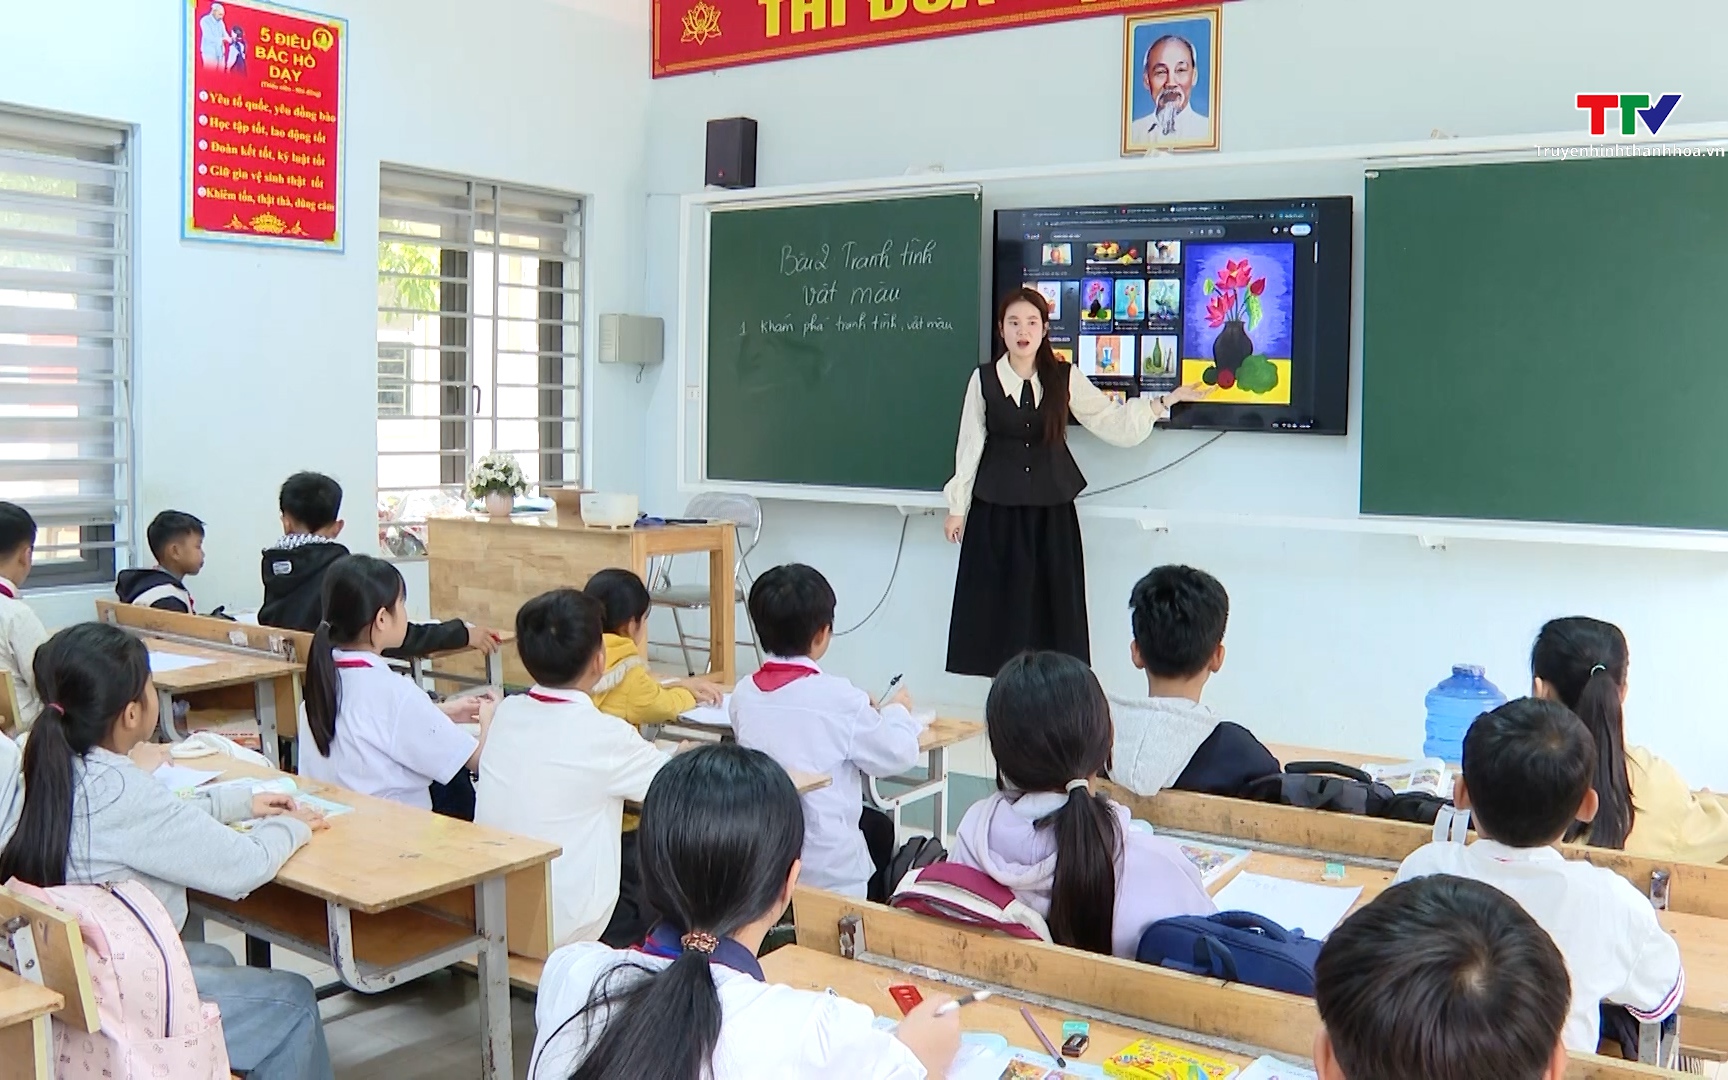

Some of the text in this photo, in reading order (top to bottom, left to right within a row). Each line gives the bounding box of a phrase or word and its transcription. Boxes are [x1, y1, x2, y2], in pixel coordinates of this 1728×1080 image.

[260, 26, 271, 43] 5
[255, 45, 289, 64] BÁC
[269, 65, 302, 83] DẠY
[209, 91, 230, 106] Yêu
[209, 116, 230, 132] Học
[270, 125, 286, 138] lao
[287, 129, 311, 144] động
[264, 171, 285, 184] sinh
[841, 239, 893, 270] Tranh
[835, 311, 866, 331] tranh
